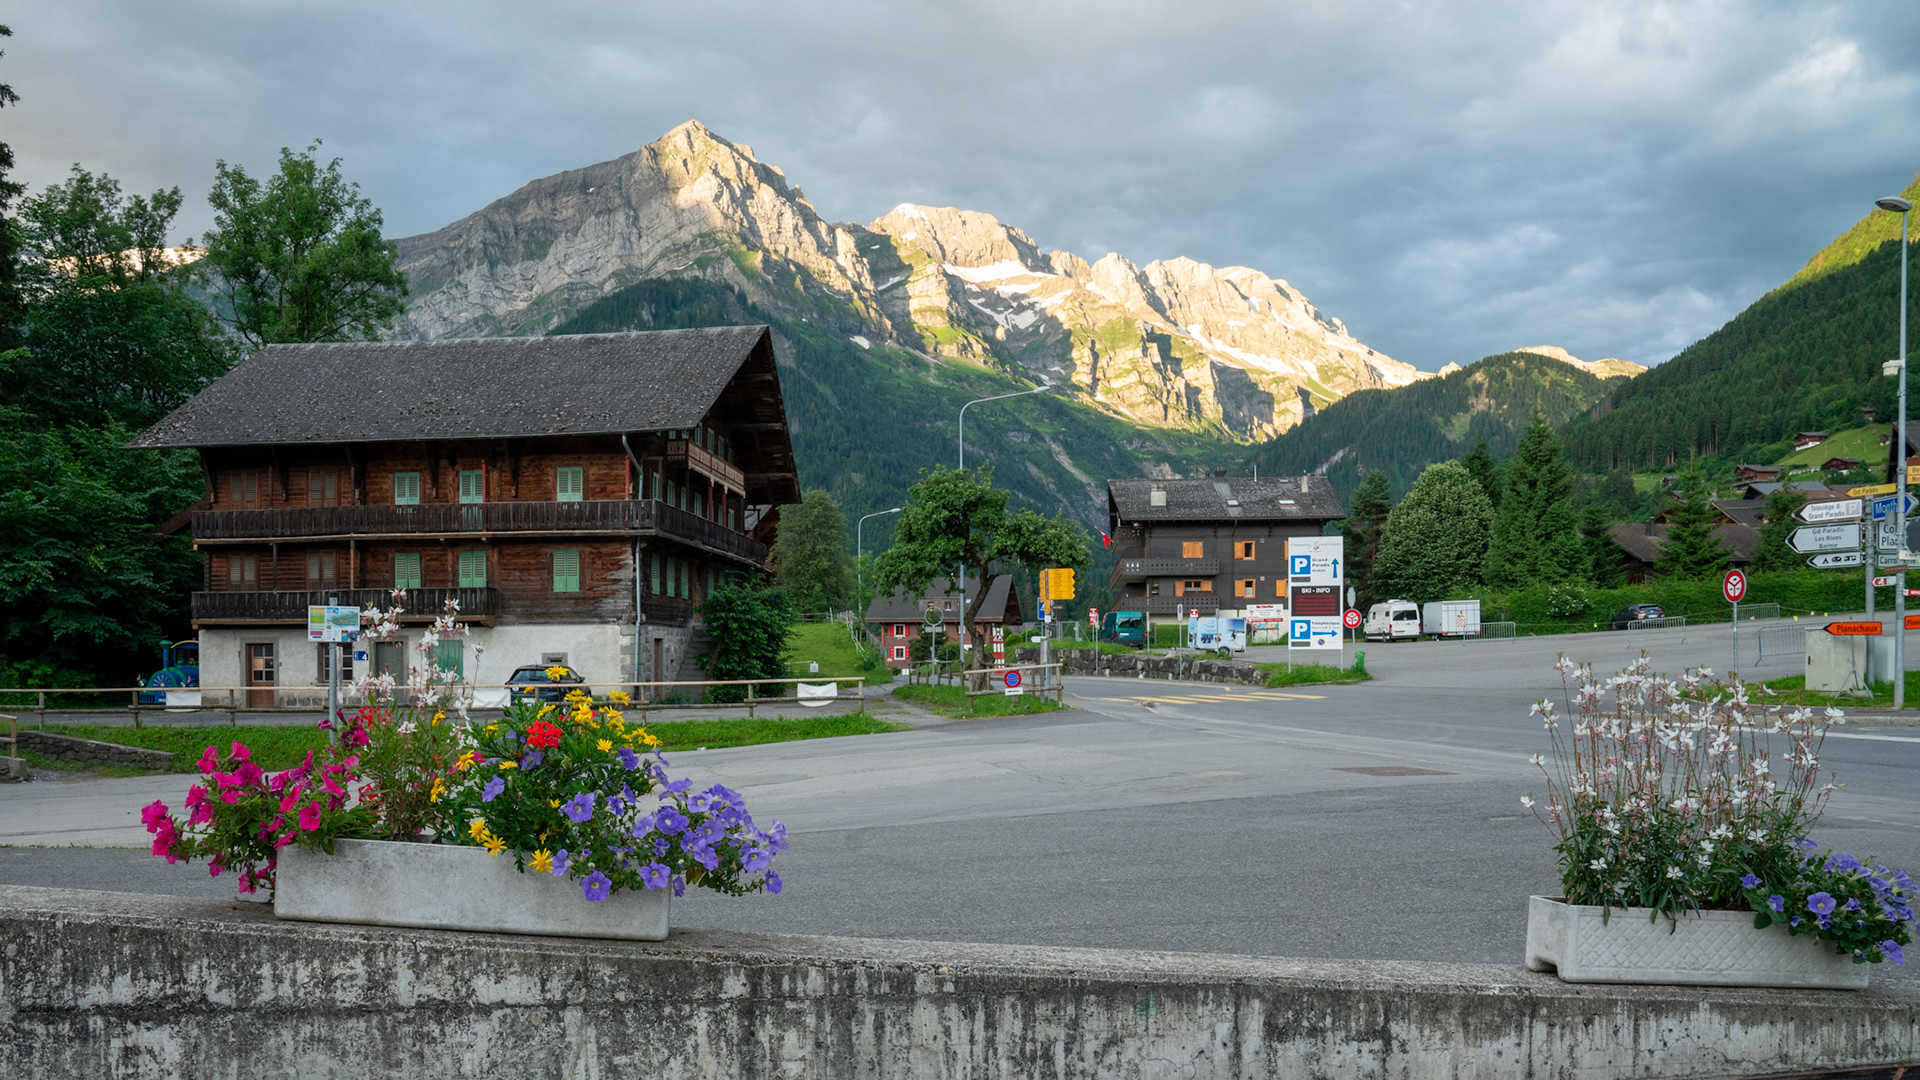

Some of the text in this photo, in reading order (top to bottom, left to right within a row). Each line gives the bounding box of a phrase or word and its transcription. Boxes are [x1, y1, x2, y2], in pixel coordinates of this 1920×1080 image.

[1875, 500, 1898, 515] Month
[1808, 510, 1845, 520] Grand Paradis
[1883, 524, 1897, 534] Col
[1881, 536, 1897, 546] Pla
[1294, 557, 1308, 573] P
[1294, 622, 1308, 638] P
[1837, 624, 1877, 632] Planachaux
[362, 653, 368, 661] 4
